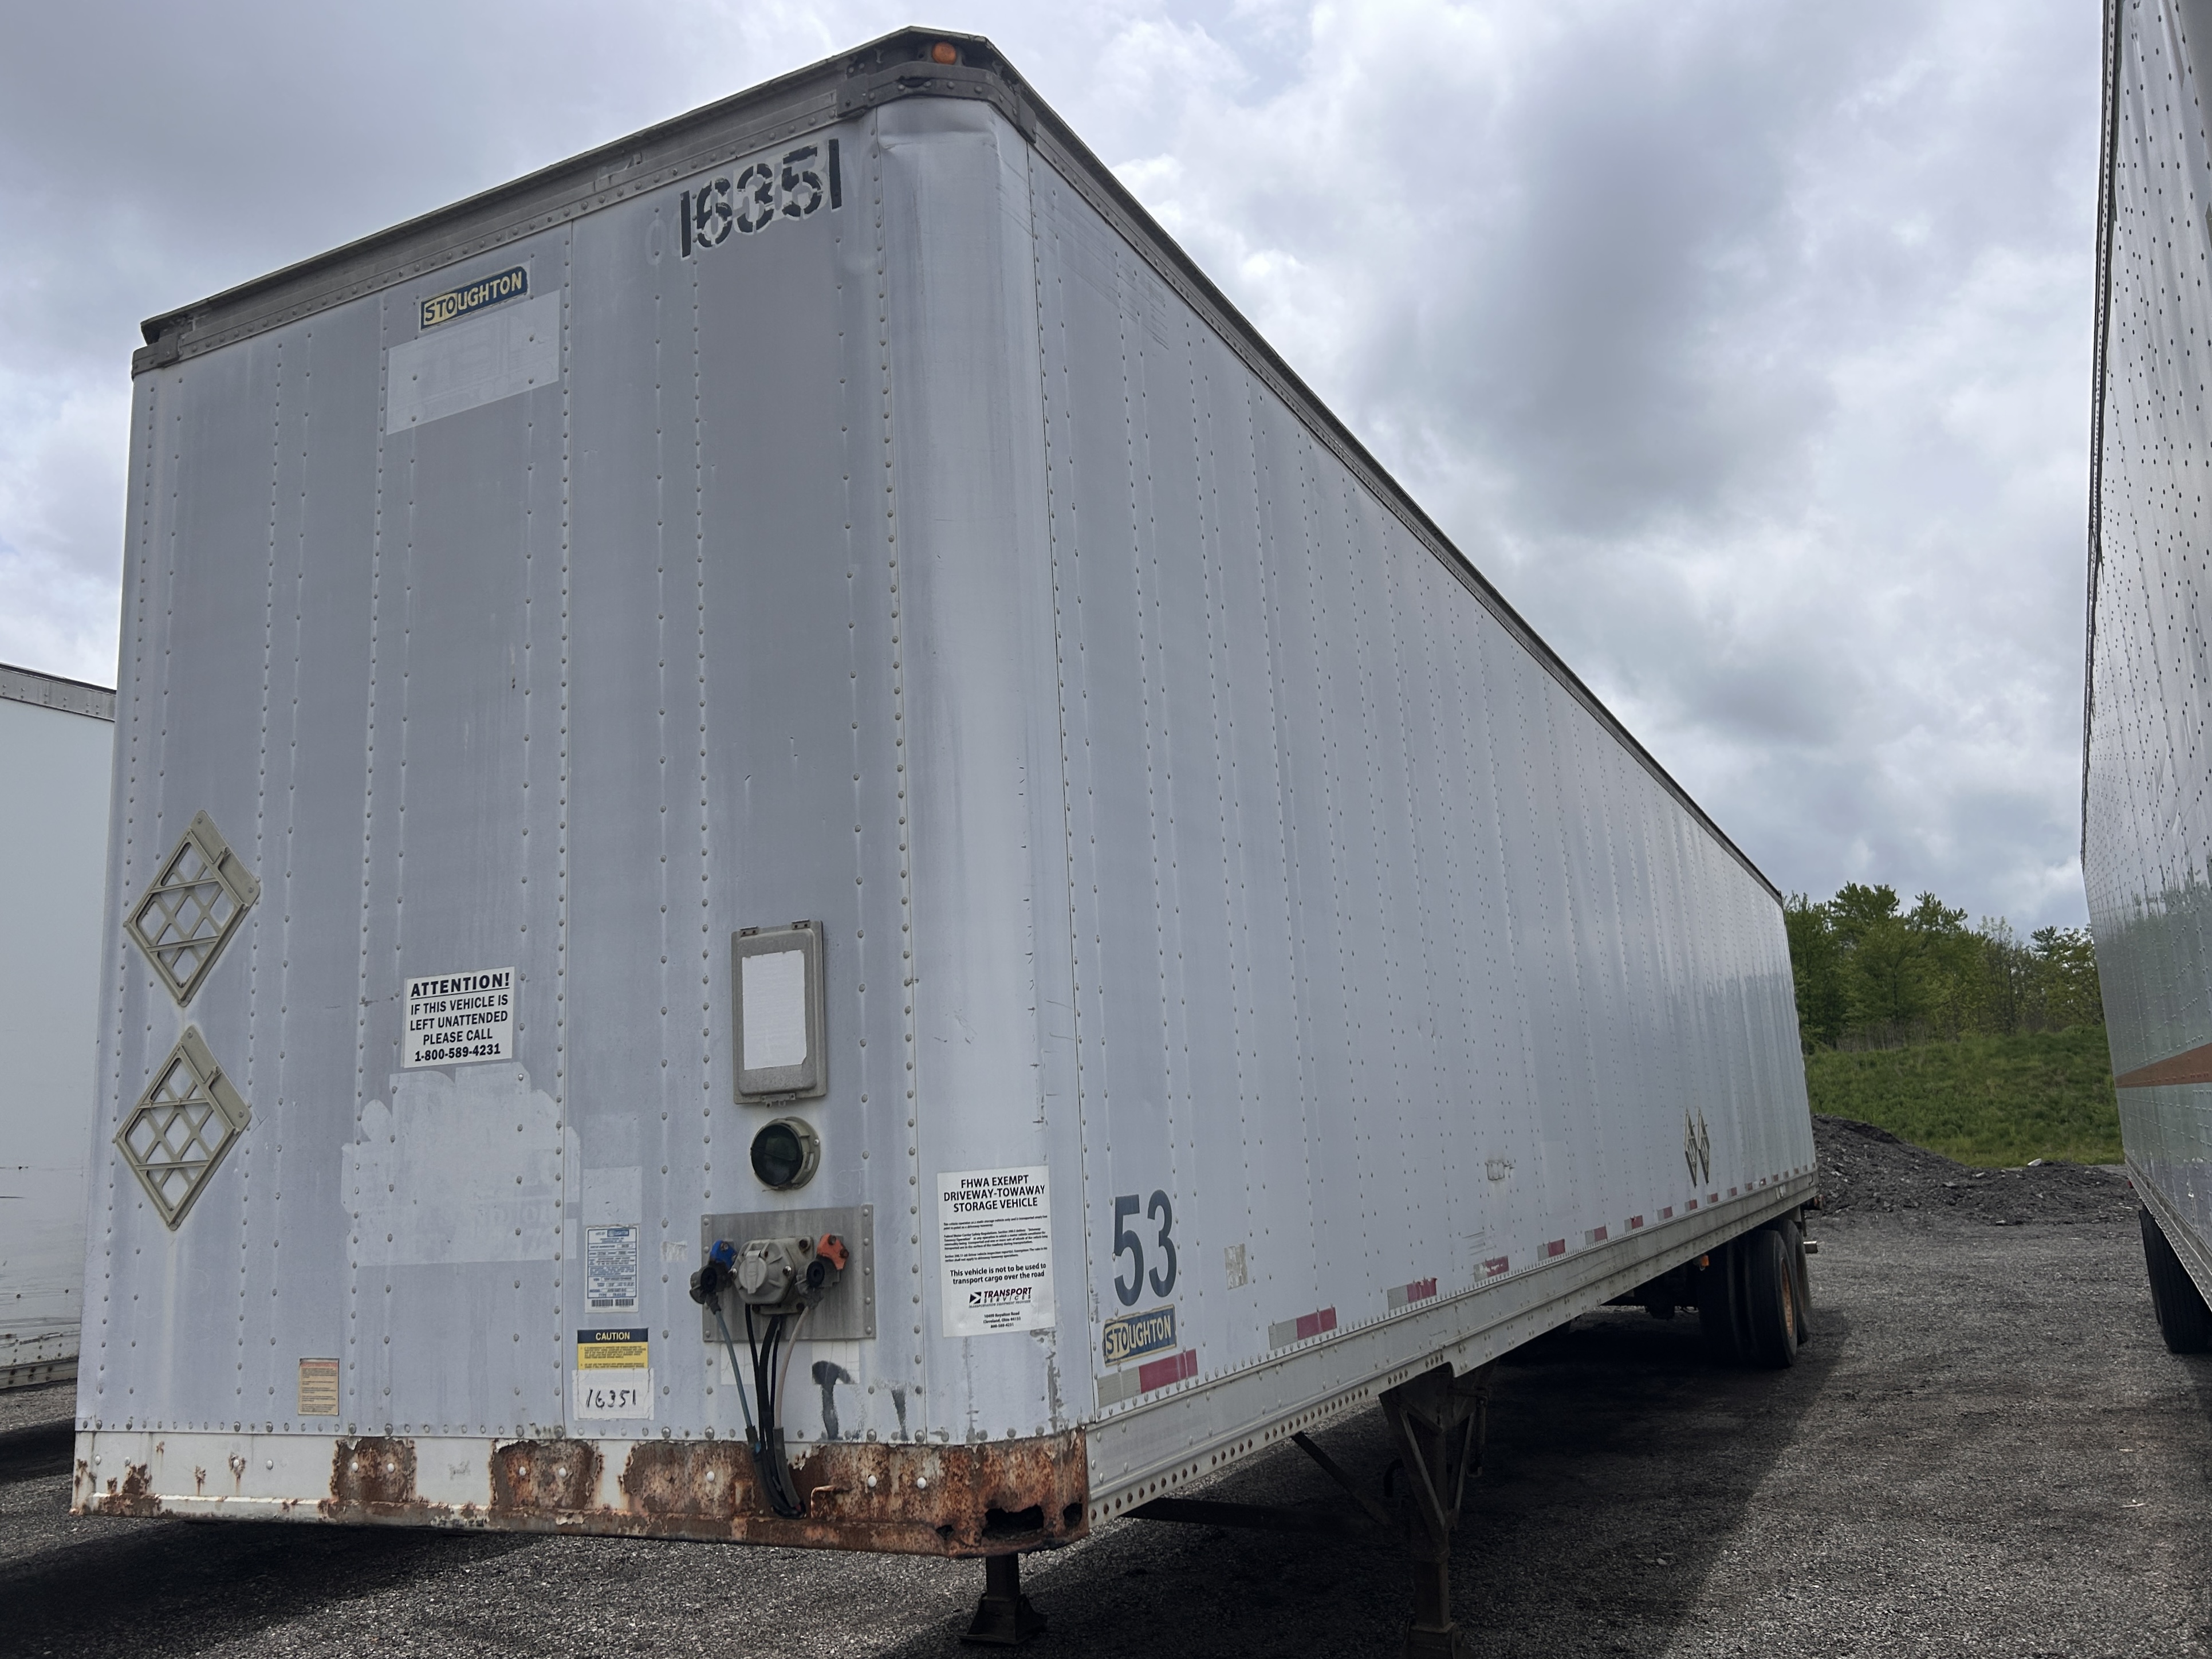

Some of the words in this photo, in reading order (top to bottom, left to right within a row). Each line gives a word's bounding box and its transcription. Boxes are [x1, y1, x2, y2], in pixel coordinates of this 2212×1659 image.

[680, 138, 842, 258] 16351
[425, 271, 522, 321] STOUGHTON
[411, 973, 510, 997] ATTENTION!
[411, 1004, 420, 1015] IF
[423, 1001, 446, 1013] THIS
[450, 996, 495, 1011] VEHICLE
[498, 994, 508, 1005] IS
[410, 1018, 435, 1031] LEFT
[438, 1011, 507, 1028] UNATTENDED
[423, 1031, 463, 1045] PLEASE
[466, 1028, 493, 1041] CALL
[415, 1043, 501, 1062] 1-800-589-4231
[961, 1177, 989, 1188] FHWA
[992, 1175, 1029, 1186] EXEMPT
[944, 1185, 1045, 1201] DRIVEWAY-TOWAWAY
[954, 1200, 997, 1212] STORAGE
[1000, 1197, 1038, 1208] VEHICLE
[1114, 1189, 1176, 1306] 53
[950, 1269, 963, 1277] This
[965, 1267, 987, 1276] vehicle
[1025, 1263, 1040, 1271] used
[953, 1276, 983, 1285] transport
[985, 1275, 1002, 1283] cargo
[983, 1294, 1031, 1303] SERVICES
[984, 1287, 1032, 1298] TRANSPORT
[596, 1331, 630, 1340] CAUTION
[1107, 1315, 1171, 1355] STOUGHTON
[585, 1389, 636, 1409] 16351
